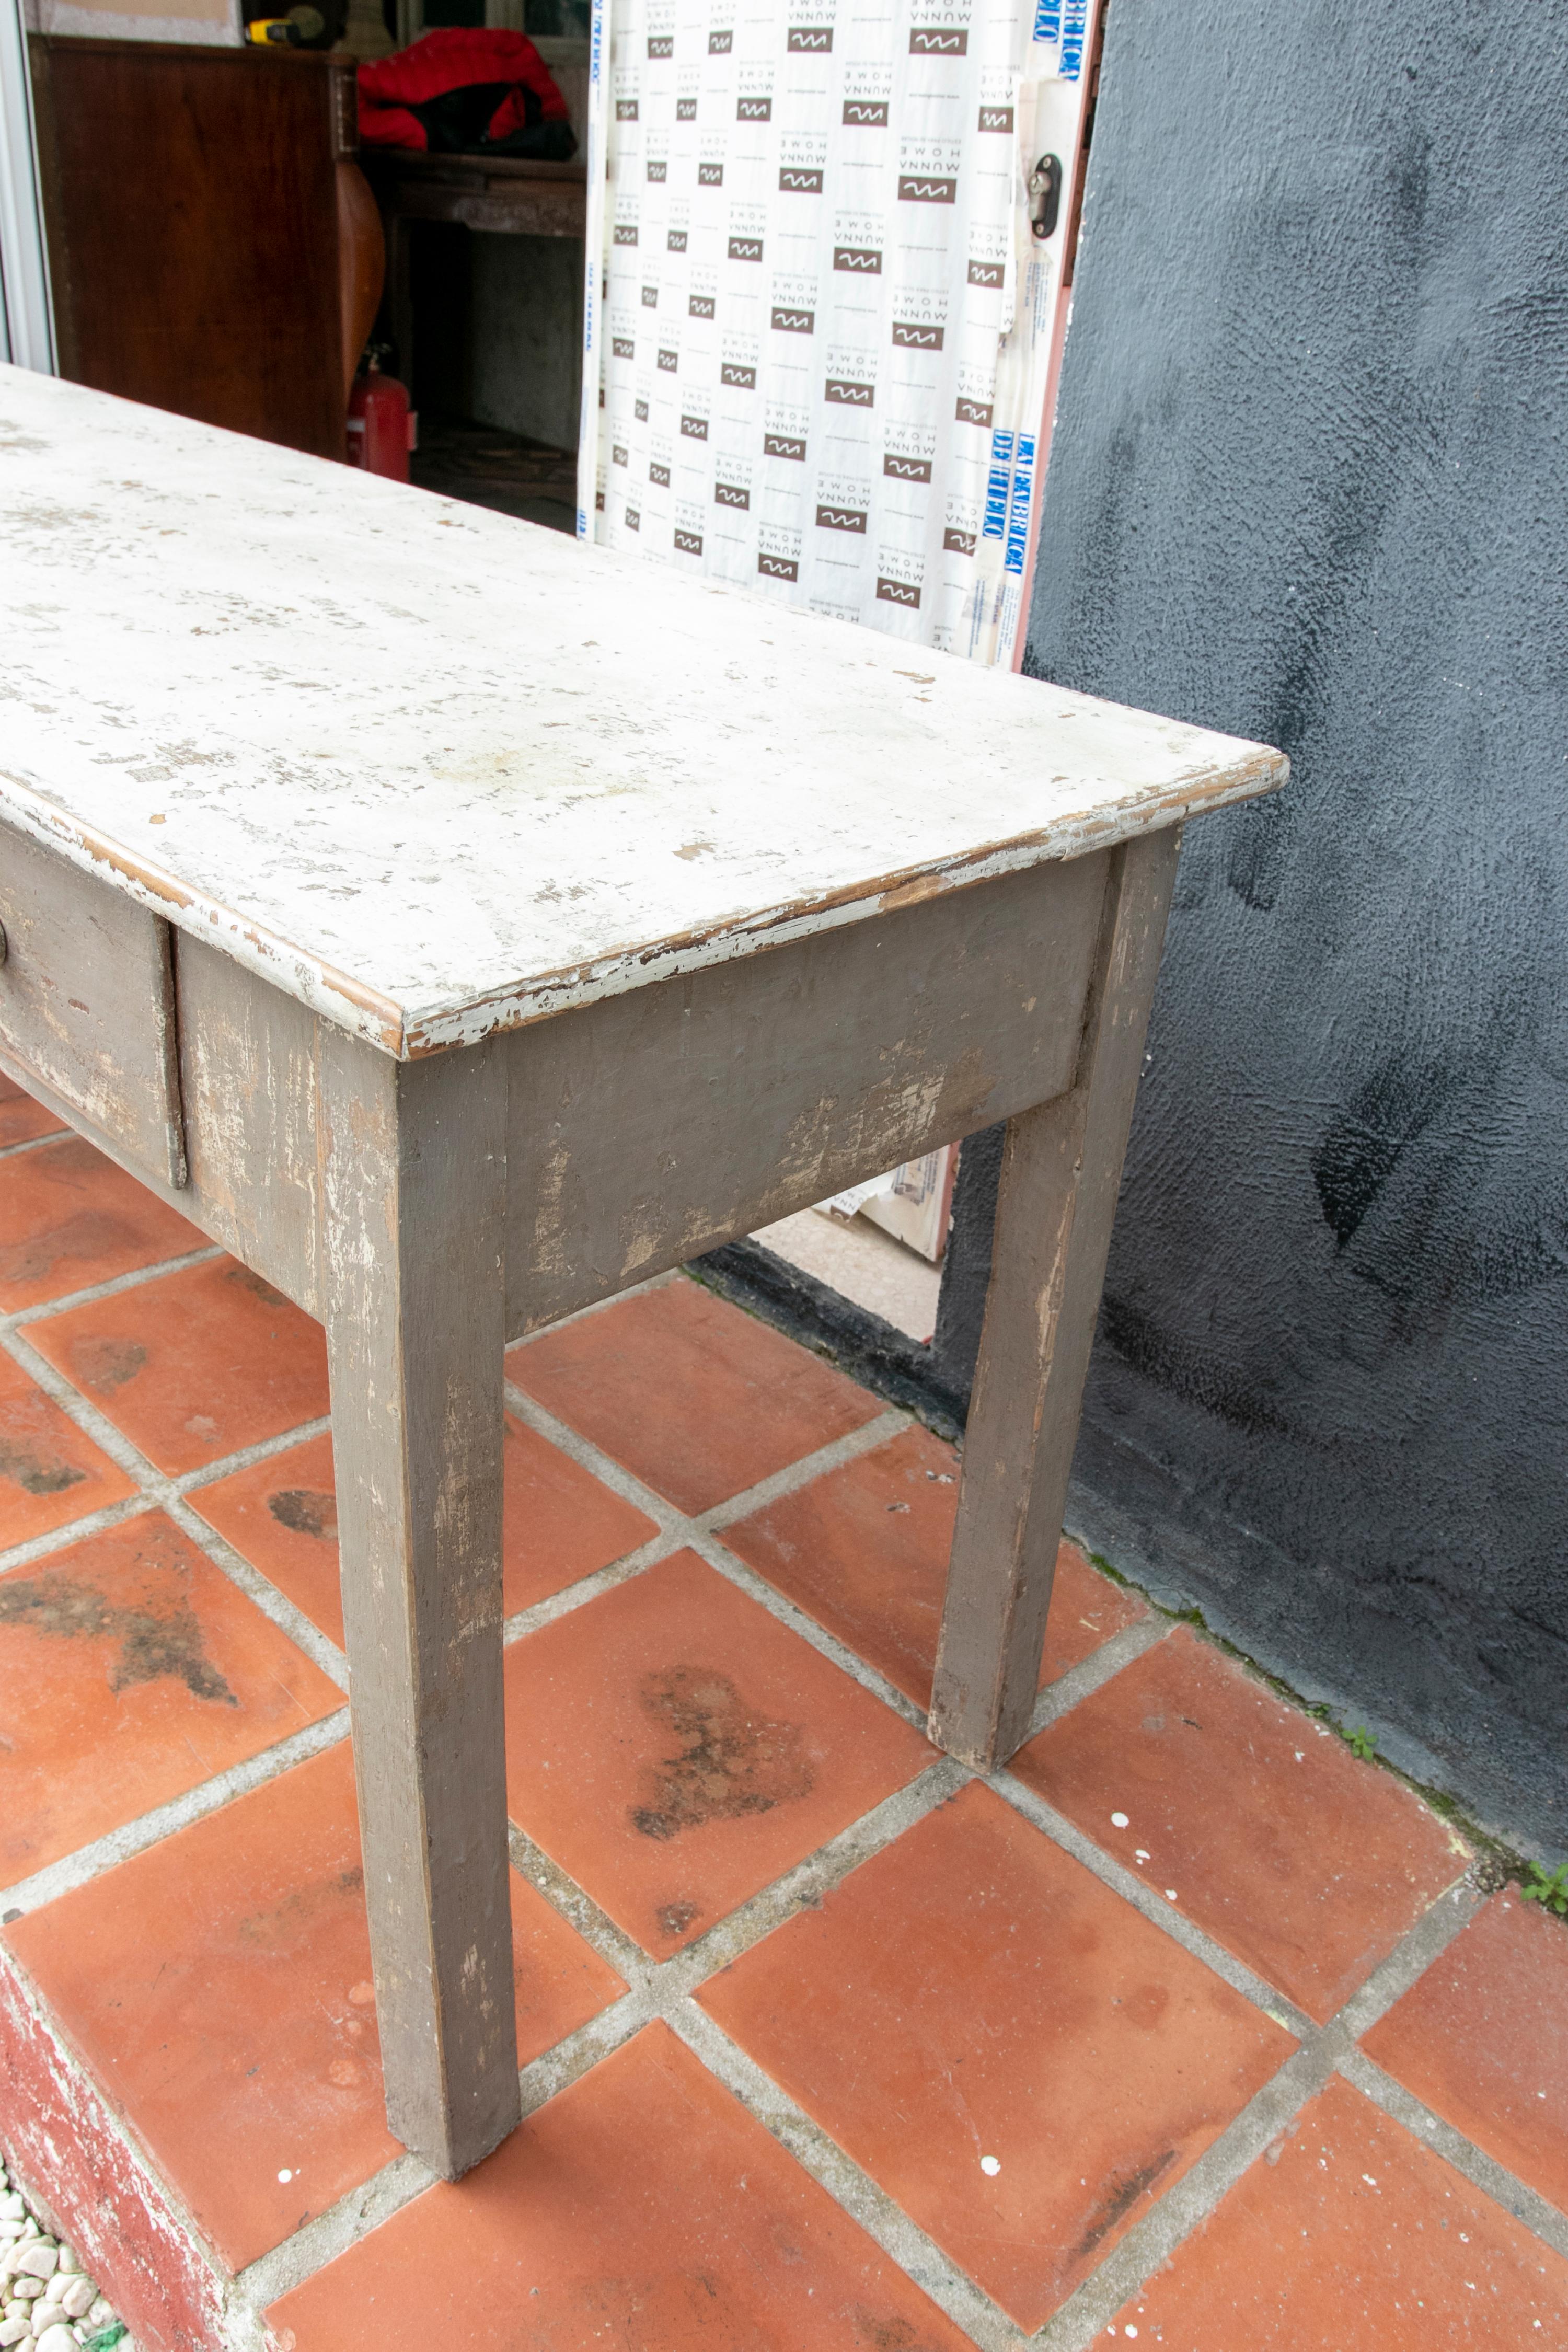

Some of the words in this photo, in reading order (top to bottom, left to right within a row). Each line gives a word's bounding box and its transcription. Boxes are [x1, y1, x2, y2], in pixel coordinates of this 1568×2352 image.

[788, 12, 836, 20] MUNNA
[911, 12, 971, 22] MUNNA
[845, 71, 892, 80] HOME
[844, 85, 891, 95] MUNNA
[781, 140, 826, 149] HOME
[780, 153, 826, 163] MUNNA
[901, 146, 960, 158] HOME
[900, 160, 960, 172] MUNNA
[730, 211, 766, 220] HOME
[729, 224, 766, 233] MUNNA
[835, 220, 884, 230] HOME
[835, 233, 884, 244] MUNNA
[773, 280, 817, 292] HOME
[771, 293, 817, 306] MUNNA
[894, 294, 948, 307] HOME
[893, 307, 947, 321] MUNNA
[826, 353, 877, 366] HOME
[826, 366, 877, 379] MUNNA
[766, 408, 809, 421] HOME
[765, 420, 809, 434] MUNNA
[885, 428, 936, 442] HOME
[884, 441, 936, 455] MUNNA
[992, 429, 1014, 461] DE
[1016, 433, 1034, 465] LA
[717, 459, 752, 472] HOME
[716, 470, 752, 485] MUNNA
[818, 480, 870, 494] HOME
[817, 492, 870, 506] MUNNA
[983, 465, 1010, 539] HIELO
[1004, 470, 1032, 574] FABRICA
[759, 529, 801, 544] HOME
[758, 540, 801, 557] MUNNA
[879, 553, 924, 570] HOME
[878, 564, 924, 582] MUNNA
